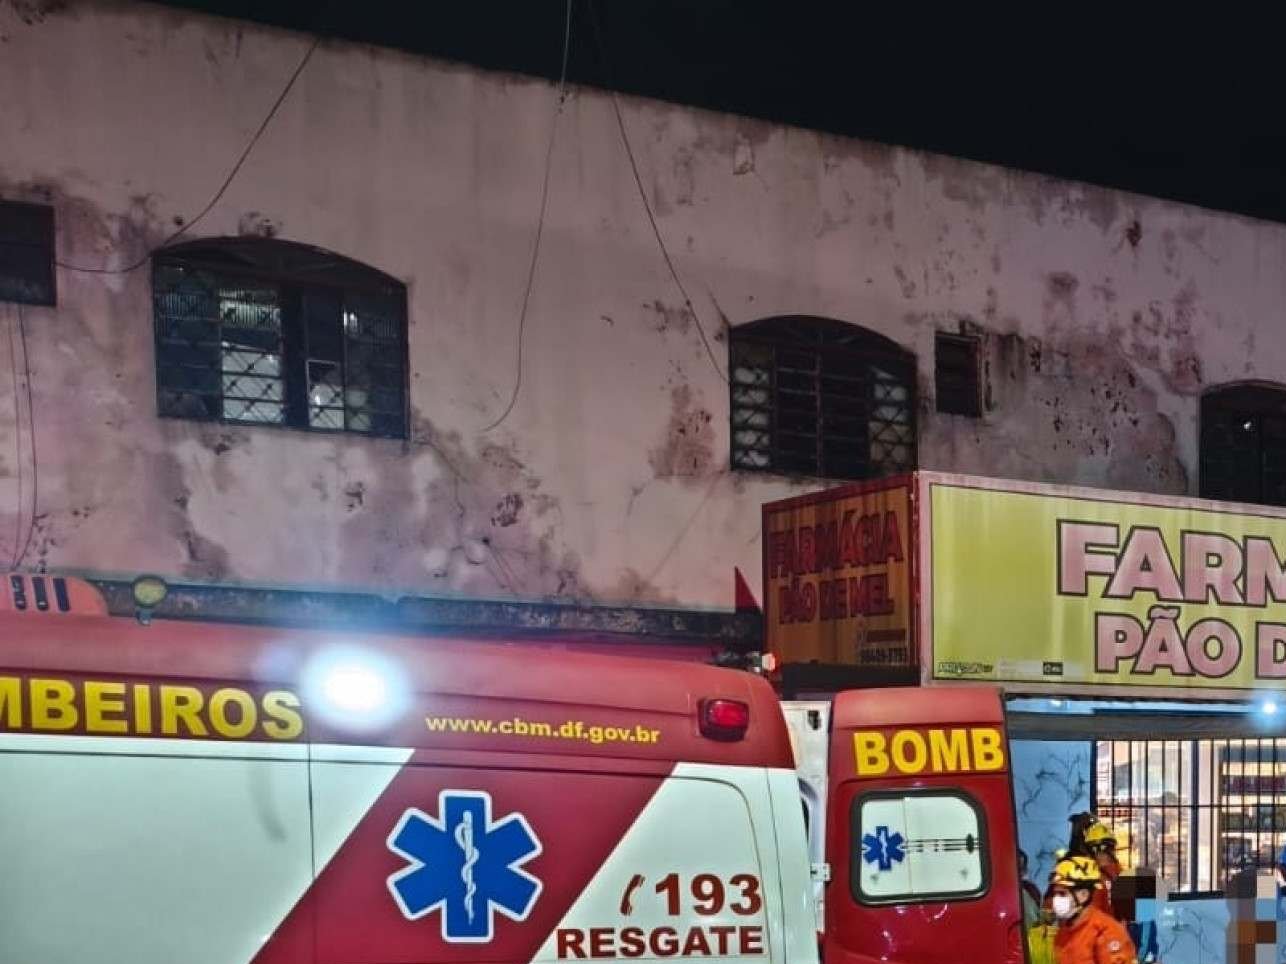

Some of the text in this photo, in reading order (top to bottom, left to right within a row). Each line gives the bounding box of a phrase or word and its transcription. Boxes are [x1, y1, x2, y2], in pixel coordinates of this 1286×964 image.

[769, 509, 904, 579] FARMÁCIA
[819, 579, 847, 621] DE
[850, 573, 895, 617] MEL
[1095, 606, 1242, 678] PÃO
[425, 714, 661, 745] www.cbm.df.gov.br
[853, 728, 1005, 777] BOMB
[654, 873, 762, 916] 193
[556, 926, 764, 960] RESGATE
